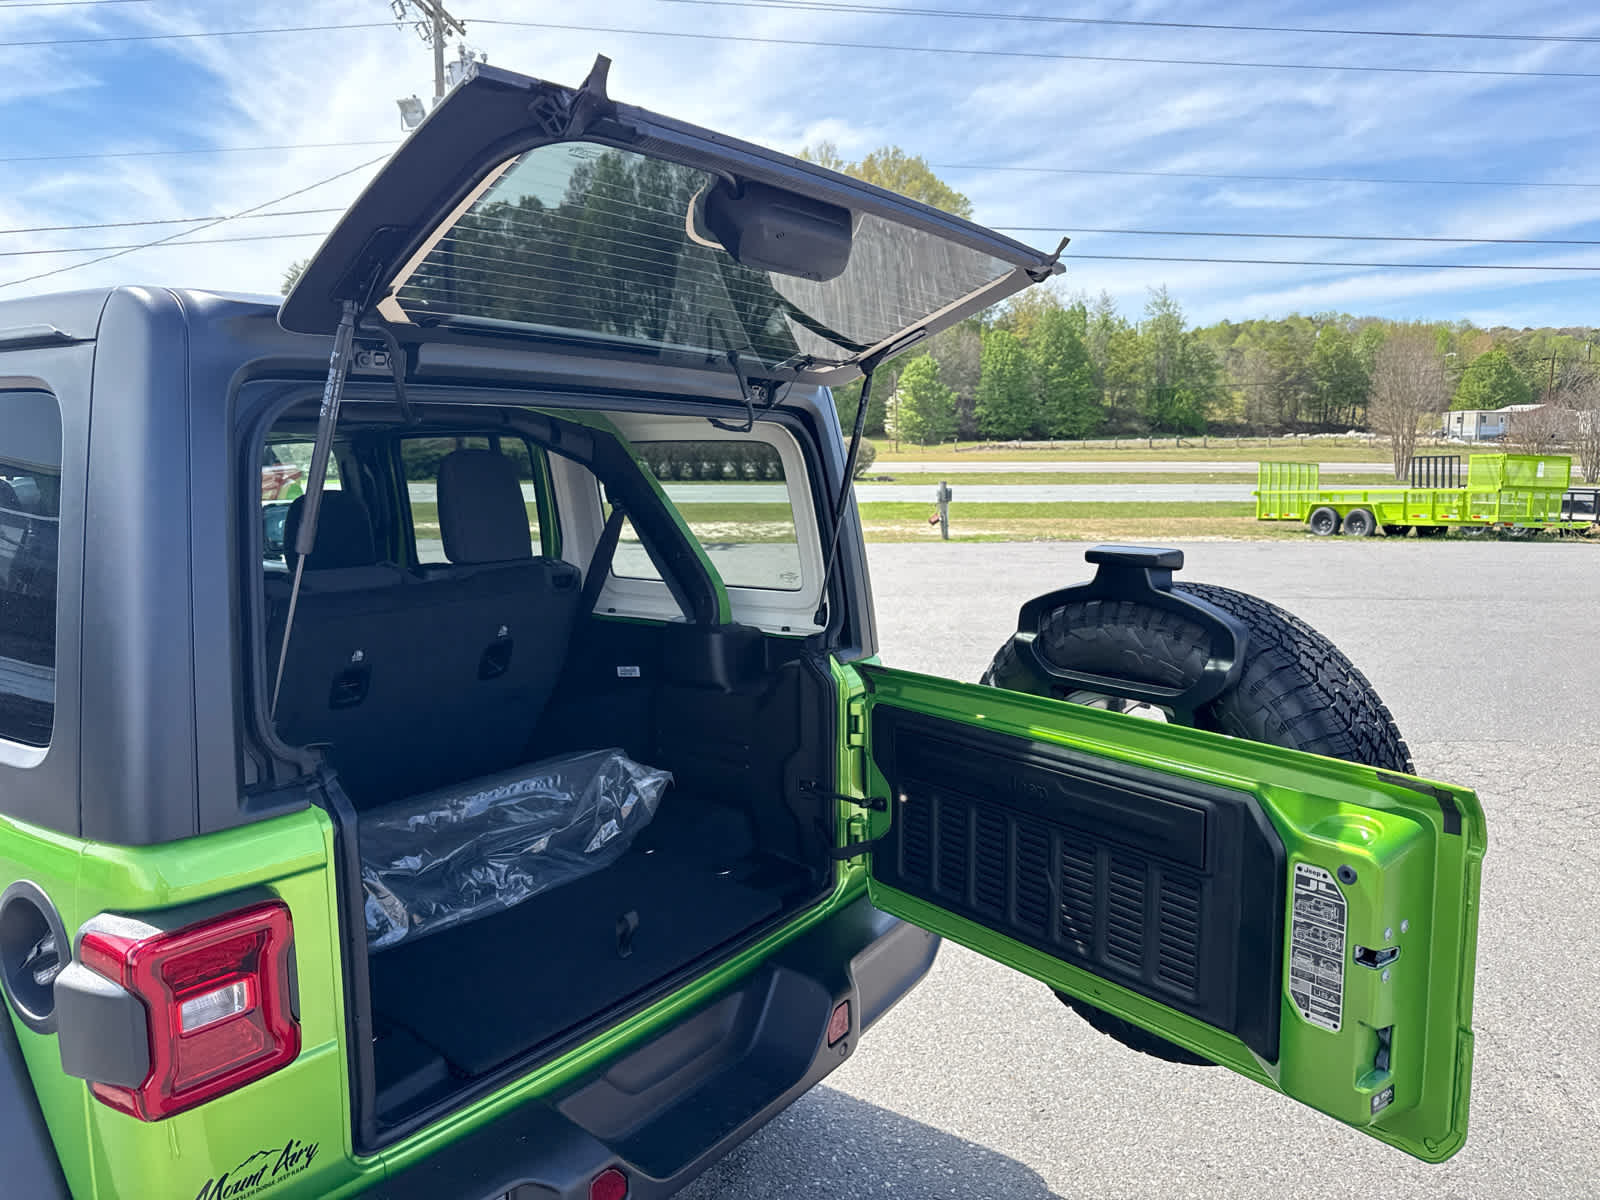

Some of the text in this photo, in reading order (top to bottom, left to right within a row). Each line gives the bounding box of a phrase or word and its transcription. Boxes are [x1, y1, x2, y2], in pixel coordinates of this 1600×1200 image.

[1303, 866, 1321, 878] Jeep
[1296, 878, 1338, 896] JL
[1313, 987, 1338, 1003] USA
[195, 1138, 320, 1200] Mount Airy
[277, 1172, 291, 1183] JEEP
[291, 1164, 306, 1176] RAM
